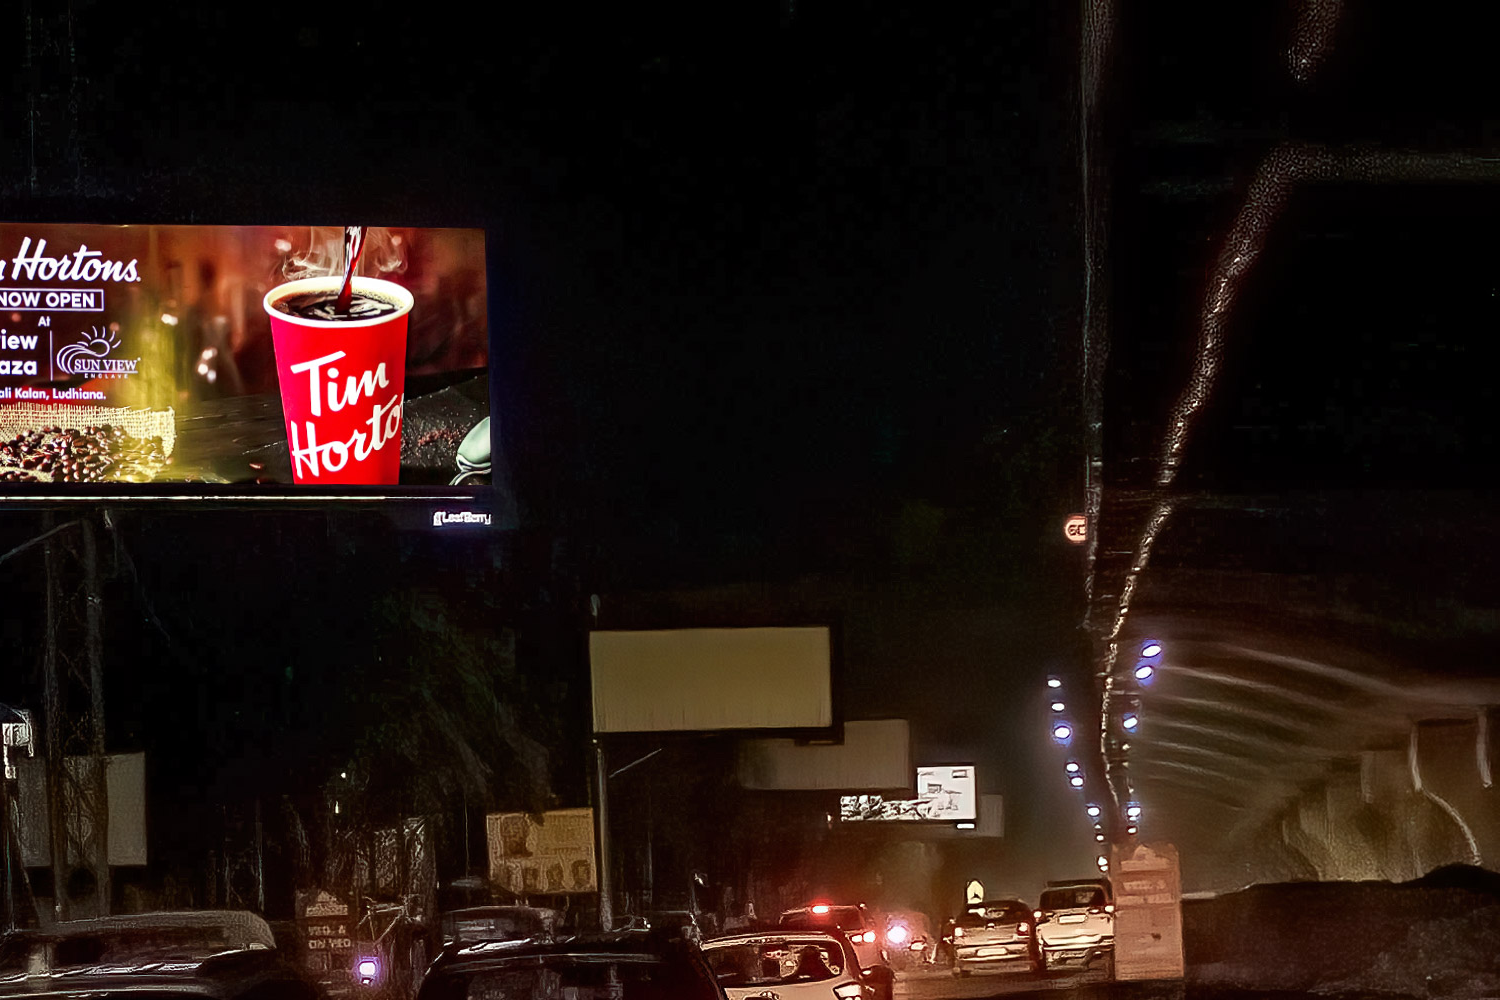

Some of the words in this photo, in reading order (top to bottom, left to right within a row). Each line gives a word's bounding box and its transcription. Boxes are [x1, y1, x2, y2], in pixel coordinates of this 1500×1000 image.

[46, 292, 96, 308] OPEN
[38, 316, 51, 327] At
[74, 359, 101, 371] SUN
[103, 359, 137, 371] VIEW
[290, 350, 389, 417] Tim
[14, 386, 50, 401] Kalan,
[52, 387, 106, 400] Ludhiana.
[290, 393, 404, 479] Horto
